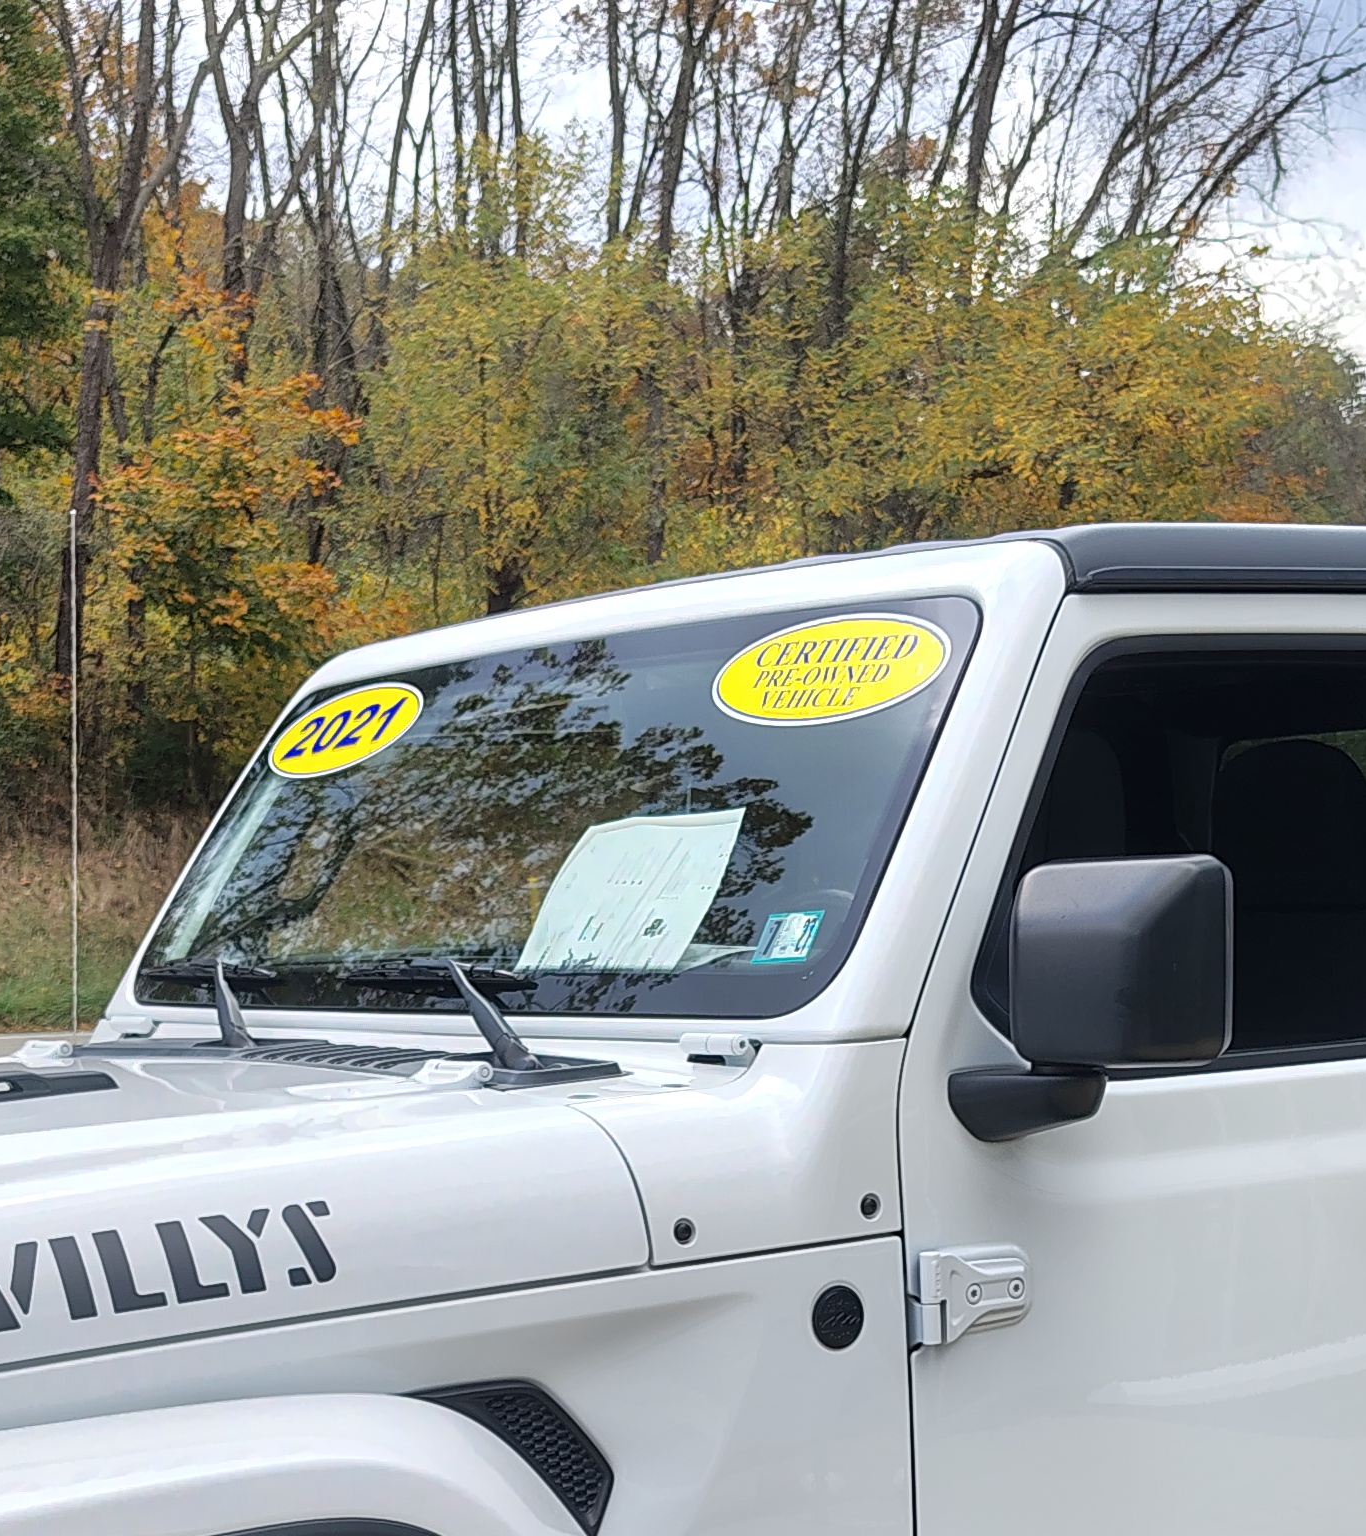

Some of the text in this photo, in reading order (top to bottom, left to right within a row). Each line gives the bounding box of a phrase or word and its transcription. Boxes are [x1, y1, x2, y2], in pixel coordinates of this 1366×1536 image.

[756, 634, 920, 668] CERTIFIED
[752, 664, 890, 690] PRE-OWNED
[761, 686, 861, 710] VEHICLE
[279, 697, 409, 763] 2021
